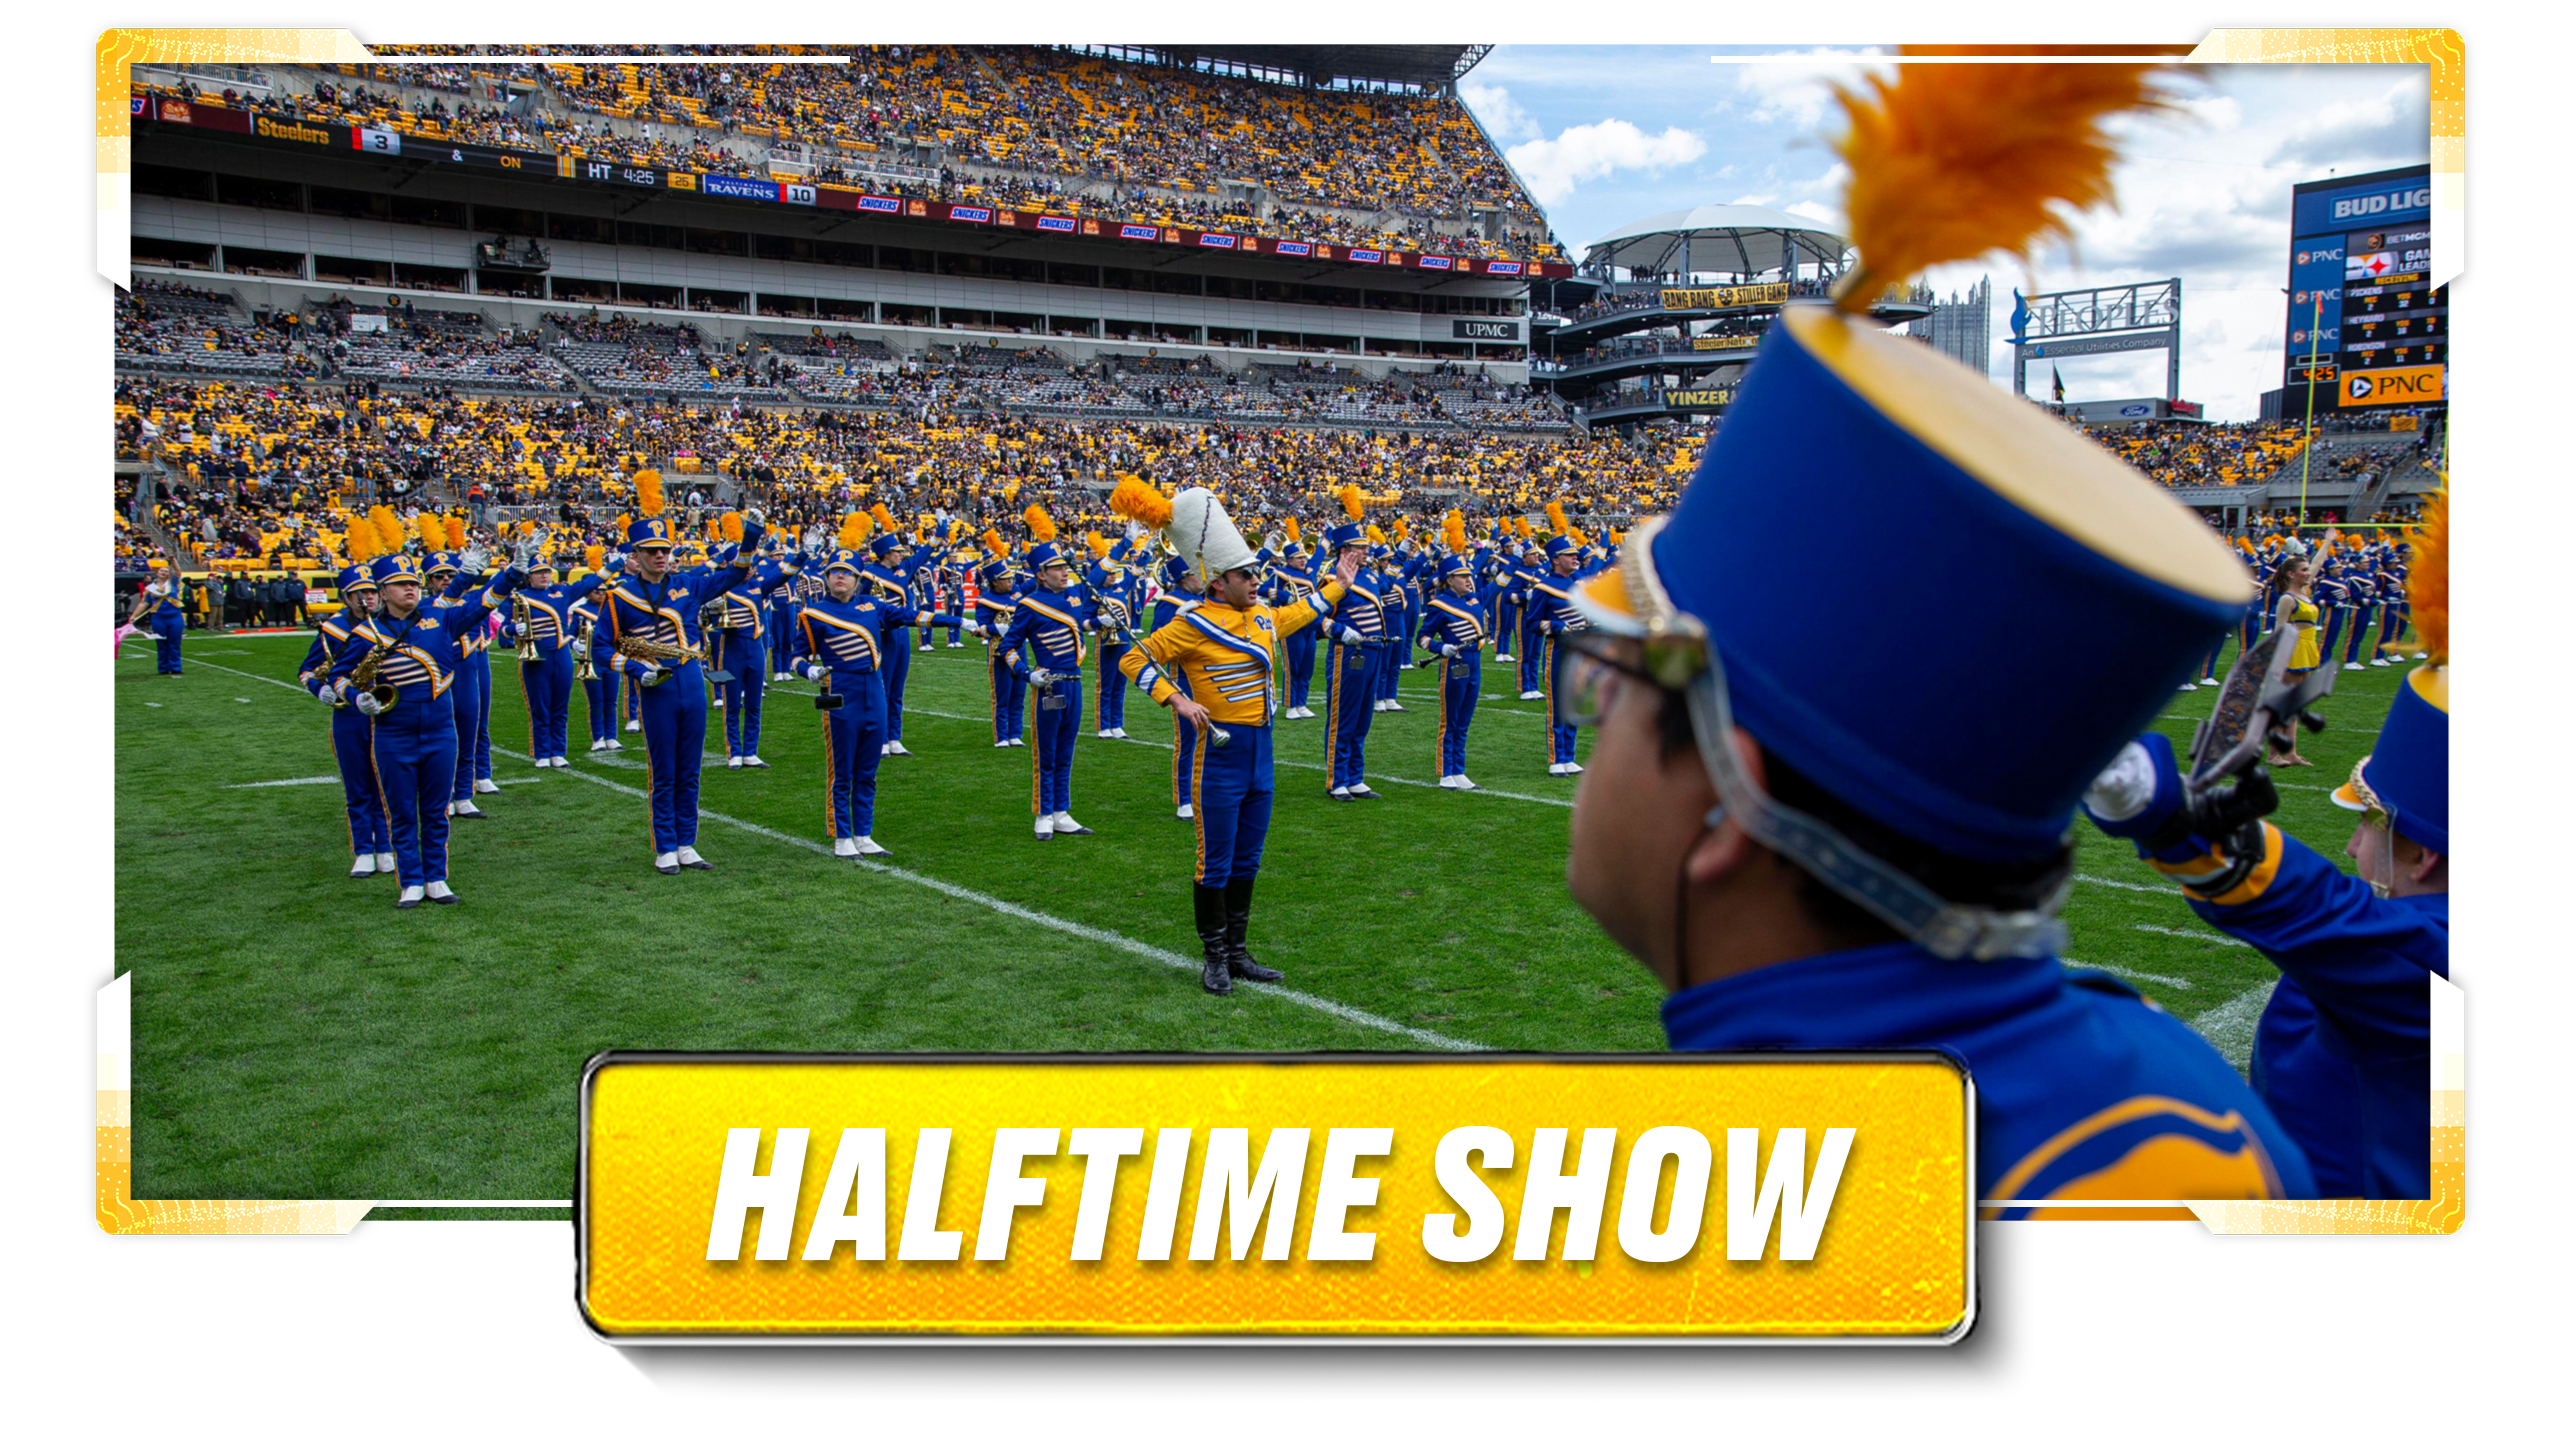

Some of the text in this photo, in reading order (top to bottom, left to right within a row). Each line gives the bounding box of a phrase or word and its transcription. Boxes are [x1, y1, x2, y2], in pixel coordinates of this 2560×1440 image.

[258, 117, 330, 145] Steelers
[375, 135, 388, 150] 3
[452, 149, 521, 169] & ON
[588, 163, 654, 185] HT 4:25
[675, 175, 689, 188] 25
[708, 184, 775, 199] RAVENS
[792, 188, 811, 202] 10
[859, 197, 899, 211] SNICKERS
[2334, 196, 2388, 218] BUD
[952, 207, 990, 221] SNICKERS
[1039, 218, 1074, 230] SNICKERS
[1122, 226, 1156, 238] SNICKERS
[1201, 234, 1234, 247] SNICKERS
[1278, 242, 1309, 254] SNICKERS
[1350, 250, 1380, 262] SNICKERS
[1420, 257, 1449, 268] SNICKERS
[2312, 248, 2343, 263] PNC
[1489, 262, 1519, 273] SNICKERS
[1663, 284, 1787, 308] BANG BANG STILLER GANG
[1465, 322, 1509, 338] UPMC
[1694, 337, 1758, 350] Steeler Natin
[2021, 337, 2167, 358] An Essential Utilities Company
[2378, 374, 2434, 396] PNC
[1666, 390, 1730, 406] YINZER
[2125, 406, 2145, 416] Ford
